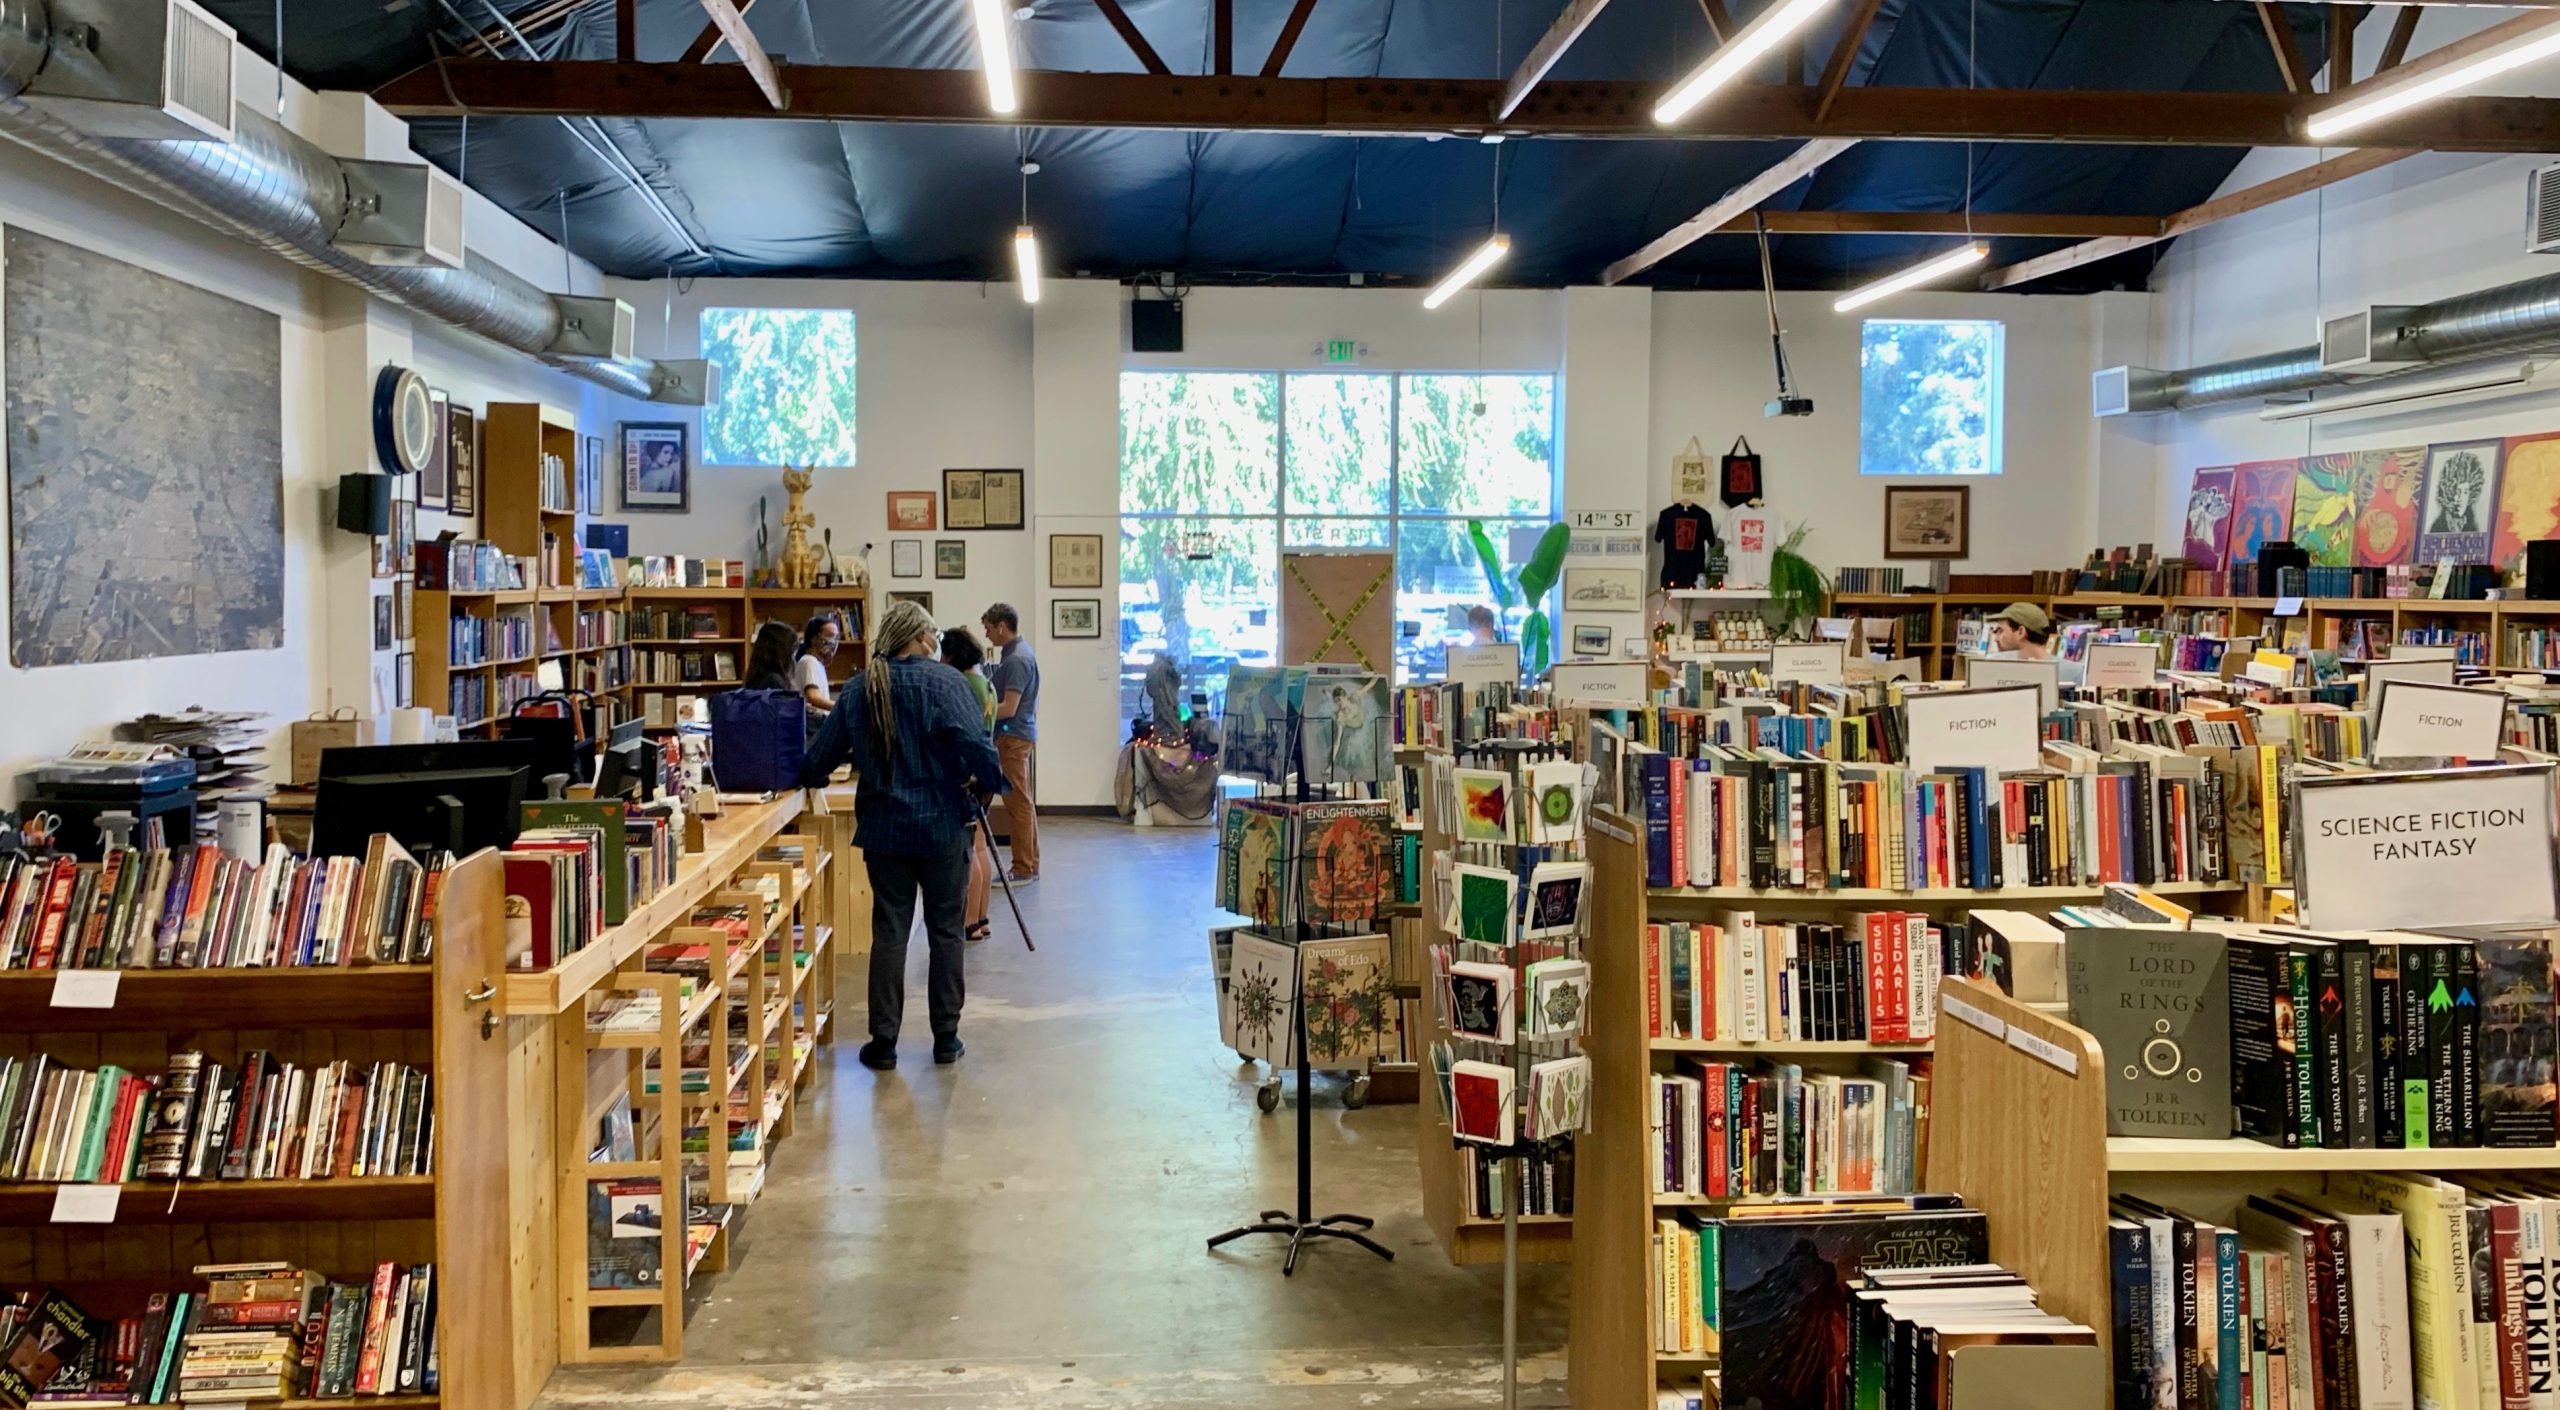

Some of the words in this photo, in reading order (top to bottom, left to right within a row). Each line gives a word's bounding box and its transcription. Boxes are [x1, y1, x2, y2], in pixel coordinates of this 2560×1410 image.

[1329, 340, 1355, 361] EXIT
[1577, 513, 1607, 527] 14TH
[1614, 513, 1633, 527] ST
[2107, 659, 2137, 667] CLASSICS
[1582, 683, 1616, 691] FICTION
[1949, 718, 1997, 732] FICTION
[2418, 715, 2464, 728] FICTION
[1808, 768, 1817, 795] James
[563, 813, 581, 823] The
[1306, 806, 1388, 820] ENLIGHTENMENT
[2320, 815, 2423, 837] SCIENCE
[2432, 808, 2526, 832] FICTION
[2373, 837, 2477, 862] FANTASY
[1743, 919, 1752, 958] DVID
[1910, 923, 1918, 950] SEDARIS
[2148, 942, 2176, 952] THE
[1307, 947, 1346, 959] Dreams
[1338, 957, 1348, 967] of
[1350, 955, 1368, 966] Edo
[1914, 953, 1923, 978] THEFT
[2129, 957, 2195, 974] LORD
[1873, 925, 1885, 1017] SEDARIS
[1893, 923, 1904, 1016] SEDARIS
[2140, 979, 2157, 988] OF
[2160, 979, 2183, 988] THE
[1650, 984, 1658, 1024] ETERNAL
[1915, 985, 1924, 1016] FINDING
[2120, 993, 2206, 1013] RINGS
[2382, 985, 2390, 1024] TOLKIEN
[2406, 990, 2415, 1006] OF
[2294, 995, 2309, 1051] HOBBIT
[2407, 1006, 2415, 1028] THE
[2329, 1034, 2337, 1055] THE
[2408, 1029, 2416, 1055] KING
[2463, 1024, 2471, 1046] THE
[2442, 1044, 2451, 1065] THE
[2331, 1059, 2339, 1083] TWO
[1709, 1072, 1718, 1111] SEASON
[1730, 1073, 1739, 1115] SHARPE
[2298, 1061, 2311, 1123] TOLKIEN
[2443, 1070, 2451, 1114] RETURN
[2463, 1050, 2472, 1129] SILMARILLION
[2118, 1108, 2207, 1125] TOLKIEN
[2332, 1087, 2342, 1132] TOWERS
[2436, 1103, 2444, 1132] KING
[2444, 1117, 2452, 1132] OF
[1861, 1238, 1966, 1265] STAR
[2333, 1250, 2345, 1280] J.R.R.
[1854, 1265, 1872, 1273] THE
[2307, 1261, 2317, 1304] TOLKIEN
[2153, 1270, 2161, 1318] PERILOUS
[2182, 1260, 2195, 1326] TOLKIEN
[2222, 1264, 2234, 1330] TOLKIEN
[2480, 1280, 2489, 1309] WELL
[2502, 1257, 2524, 1337] Inklings
[47, 1302, 91, 1339] chandler
[2336, 1284, 2349, 1335] TOLKIEN
[2522, 1257, 2552, 1394] TOLKIEN
[328, 1332, 342, 1373] JEMISIN
[2183, 1347, 2190, 1361] OF
[2184, 1362, 2192, 1400] MALDON
[2508, 1341, 2525, 1394] Carpenter
[14, 1384, 31, 1402] slee
